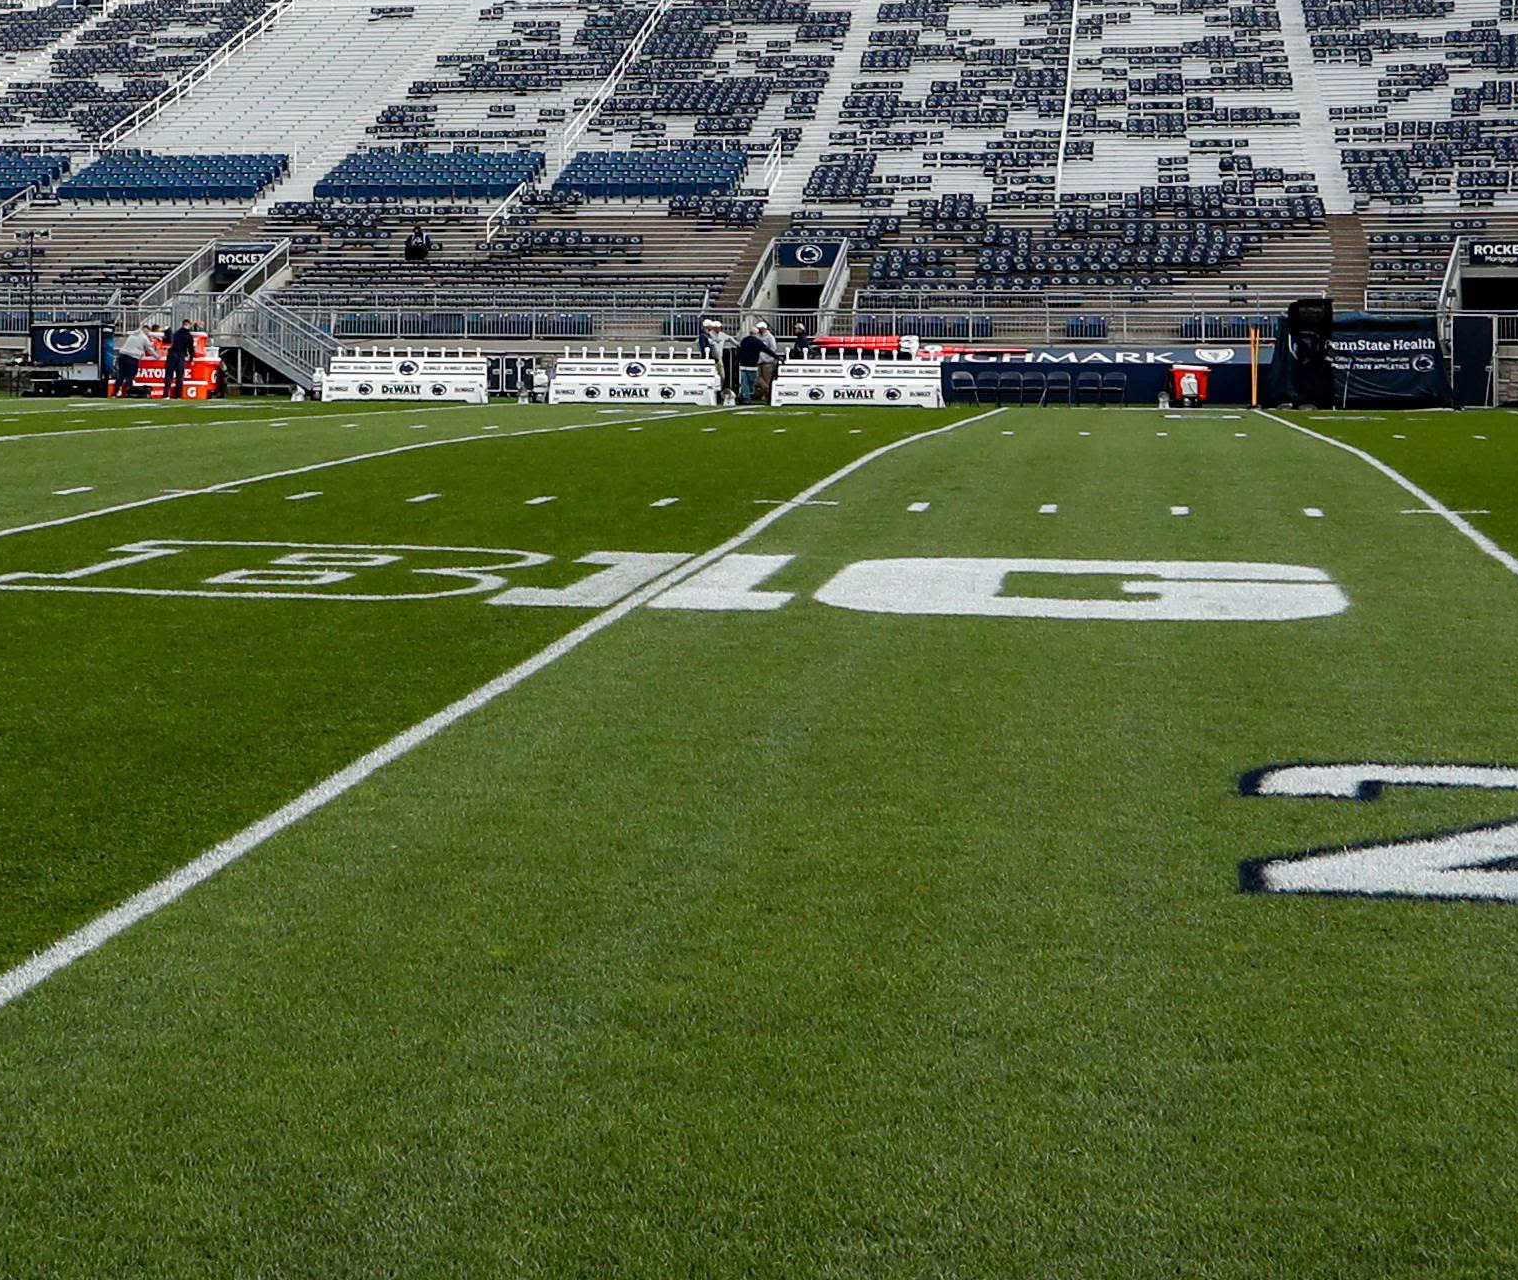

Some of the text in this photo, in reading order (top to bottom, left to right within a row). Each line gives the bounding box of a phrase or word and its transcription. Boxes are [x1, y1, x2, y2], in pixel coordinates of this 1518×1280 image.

[218, 253, 264, 264] ROCKET
[1393, 338, 1436, 350] Health
[381, 384, 421, 394] DEWALT
[609, 387, 650, 398] DEWALT
[833, 388, 875, 400] DEWALT
